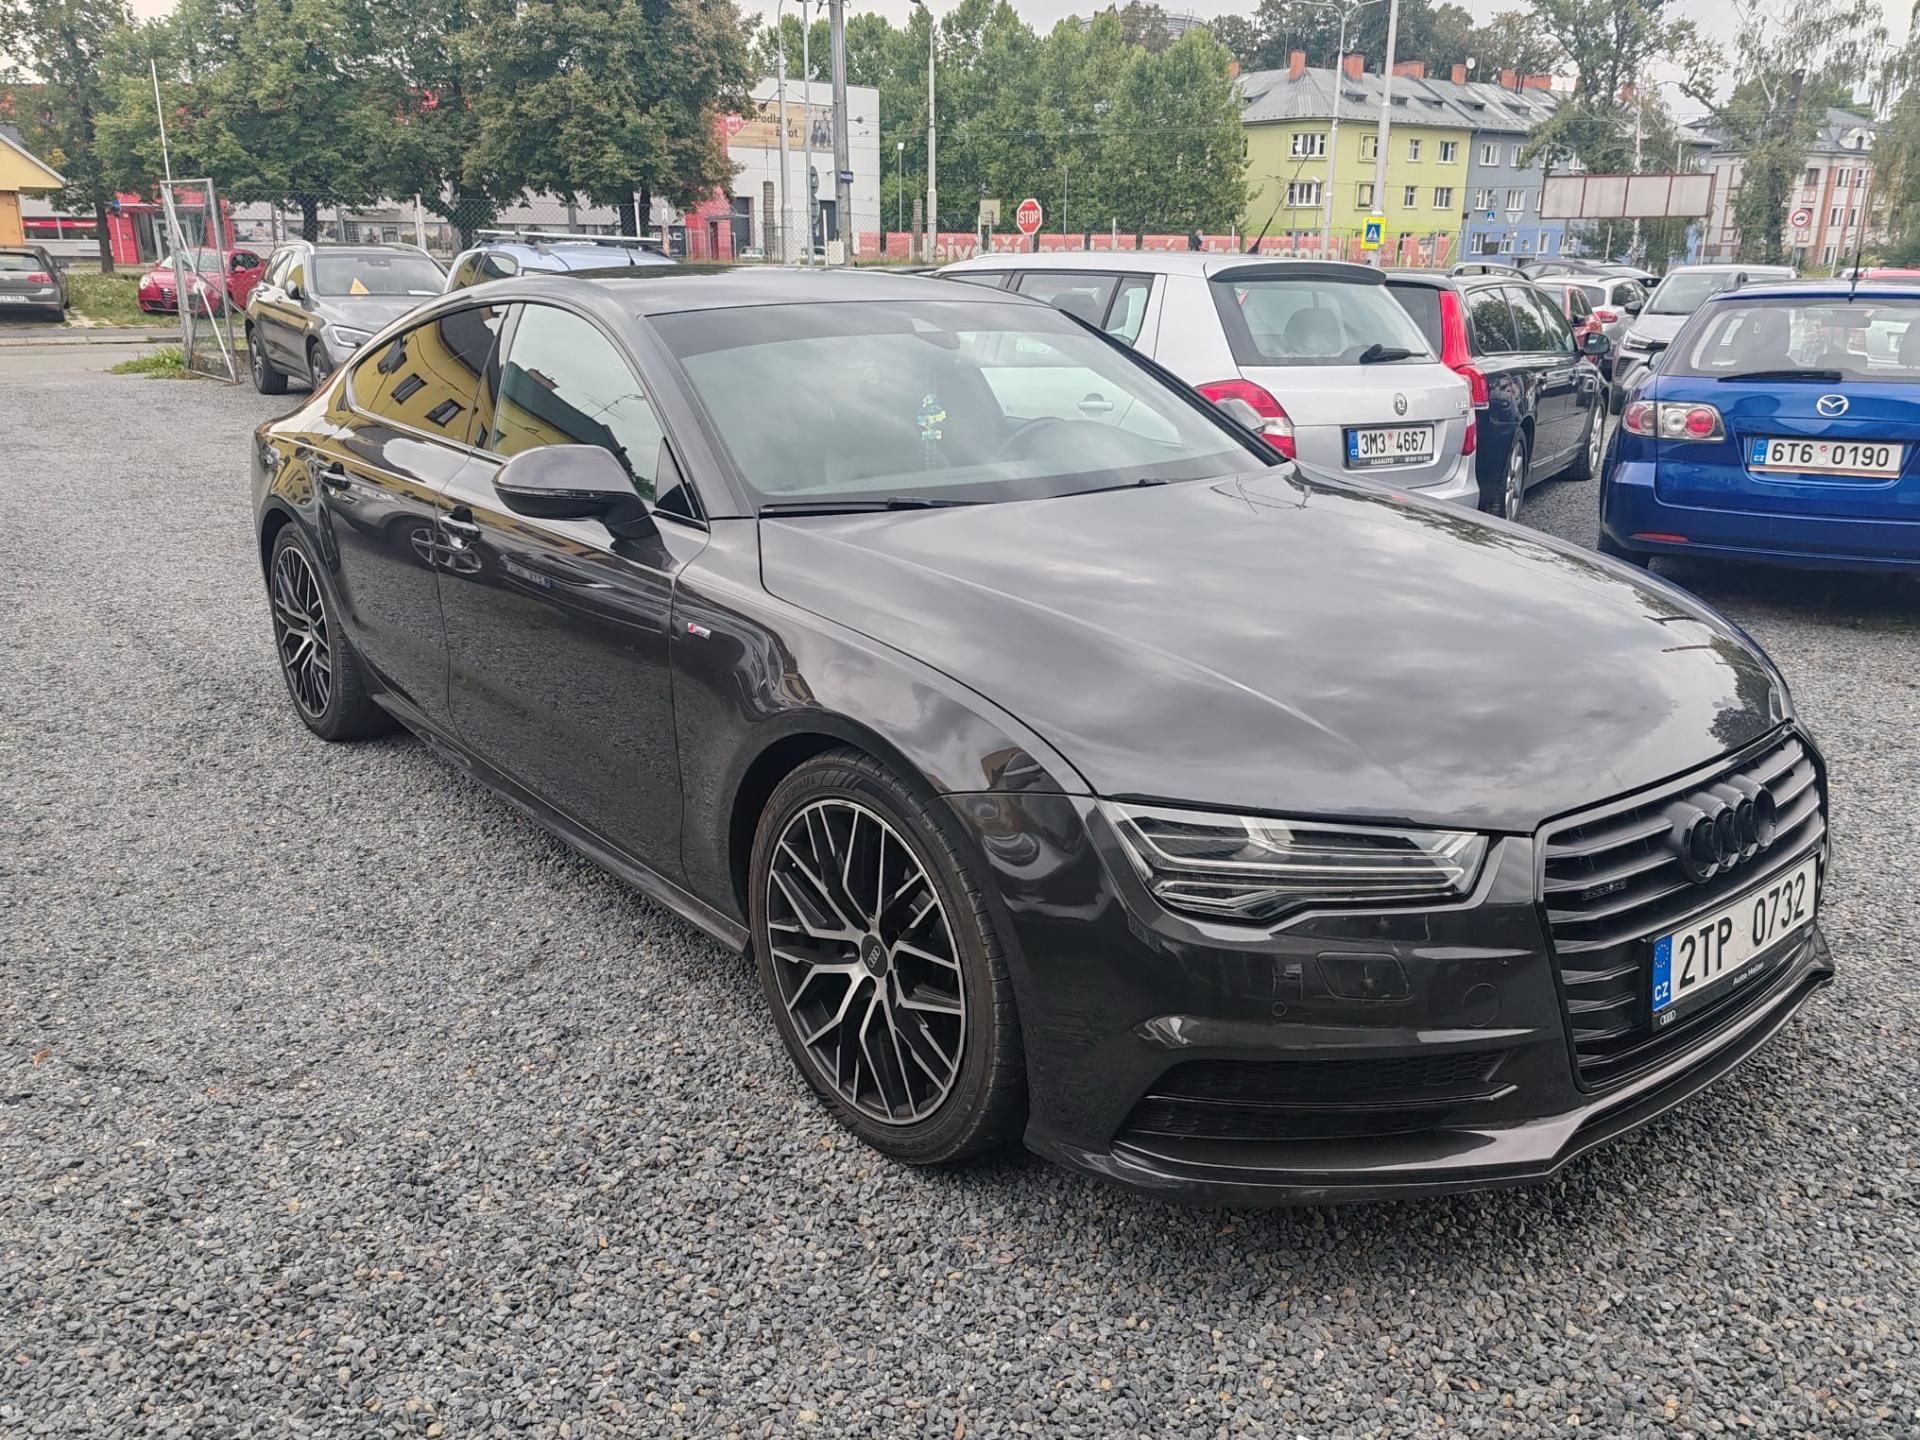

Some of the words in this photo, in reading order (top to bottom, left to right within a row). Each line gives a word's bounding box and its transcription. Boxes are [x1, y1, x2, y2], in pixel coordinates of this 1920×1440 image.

[1019, 211, 1040, 225] STOP
[1361, 432, 1386, 455] 3M3
[1396, 431, 1427, 453] 4667
[1771, 442, 1814, 463] 6T6
[1831, 445, 1890, 467] 0190
[1654, 980, 1669, 1001] CZ
[1679, 916, 1733, 991] 2TP
[1752, 871, 1806, 947] 0732
